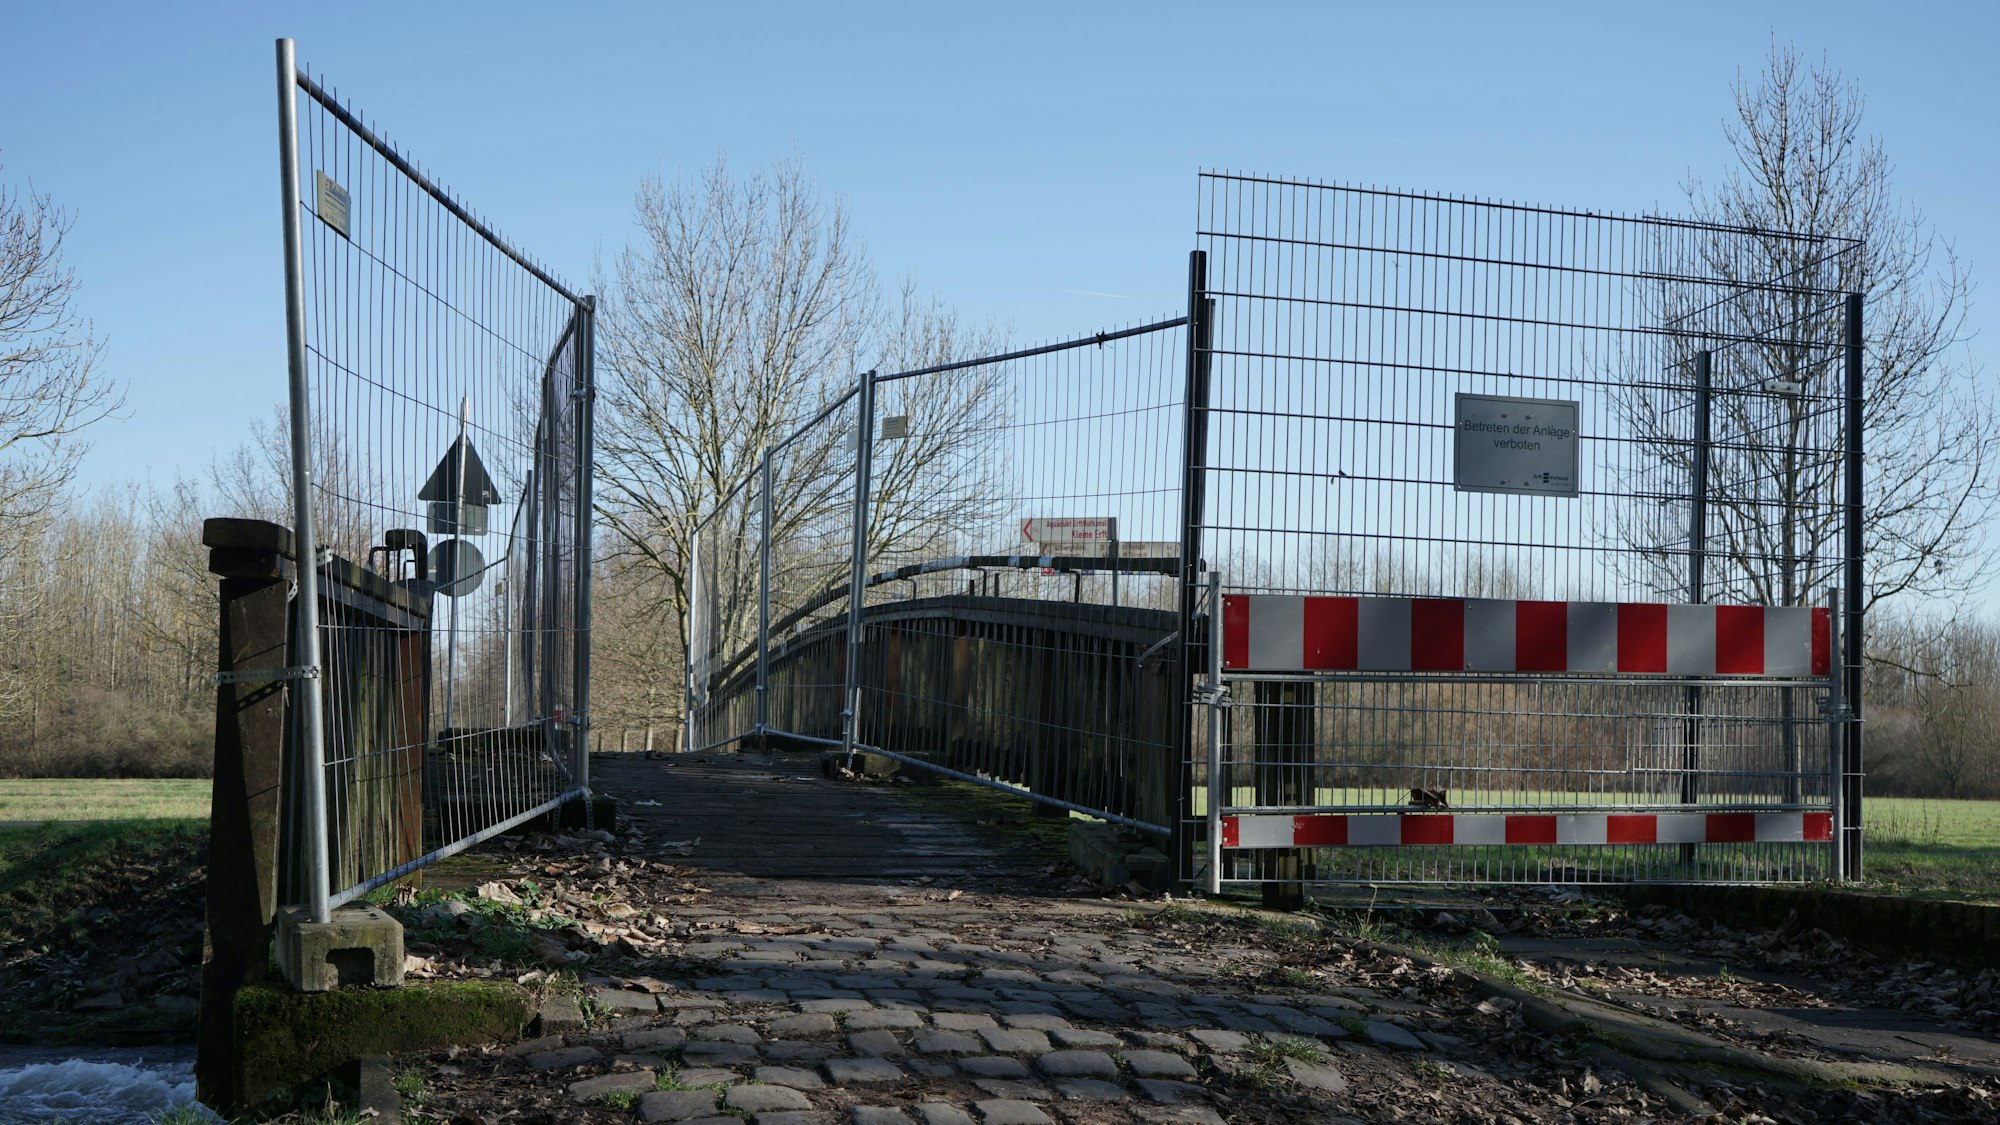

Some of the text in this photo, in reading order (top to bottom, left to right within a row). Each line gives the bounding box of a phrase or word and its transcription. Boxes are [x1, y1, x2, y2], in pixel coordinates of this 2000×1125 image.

[1464, 420, 1570, 439] Betreten der Anlage
[1493, 440, 1540, 451] verboten
[1094, 530, 1107, 539] Erft
